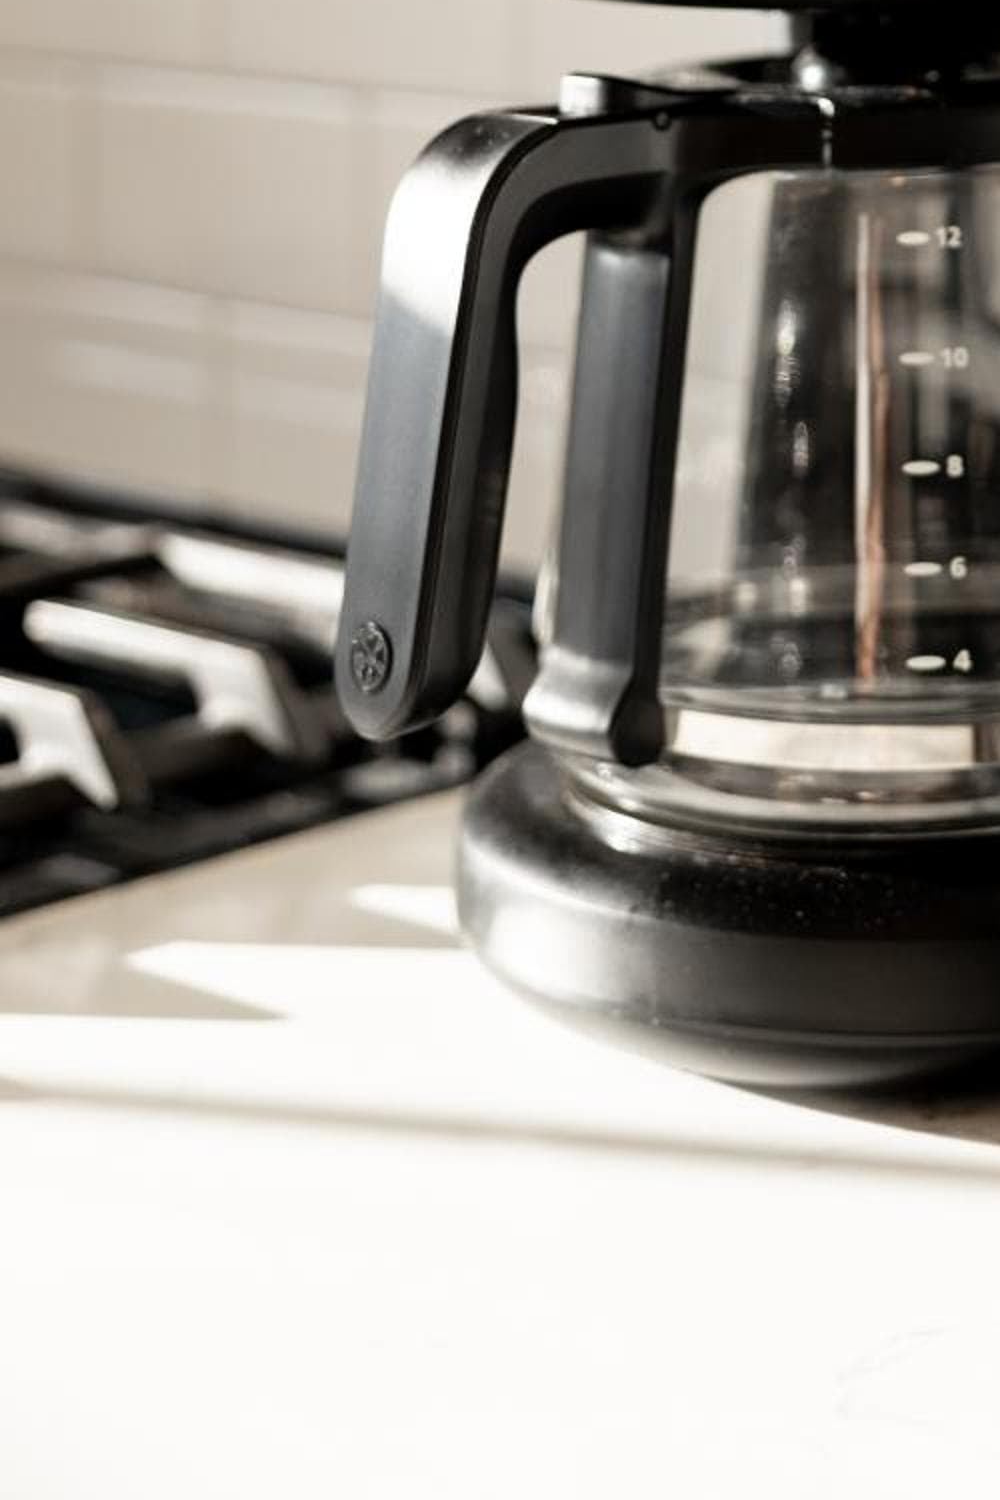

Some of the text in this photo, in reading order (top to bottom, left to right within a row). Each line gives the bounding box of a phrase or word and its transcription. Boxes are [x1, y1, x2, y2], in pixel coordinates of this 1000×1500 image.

[936, 226, 962, 247] 12
[941, 348, 968, 368] 10
[946, 456, 964, 478] 8
[950, 557, 967, 580] 6
[952, 649, 972, 672] 4
